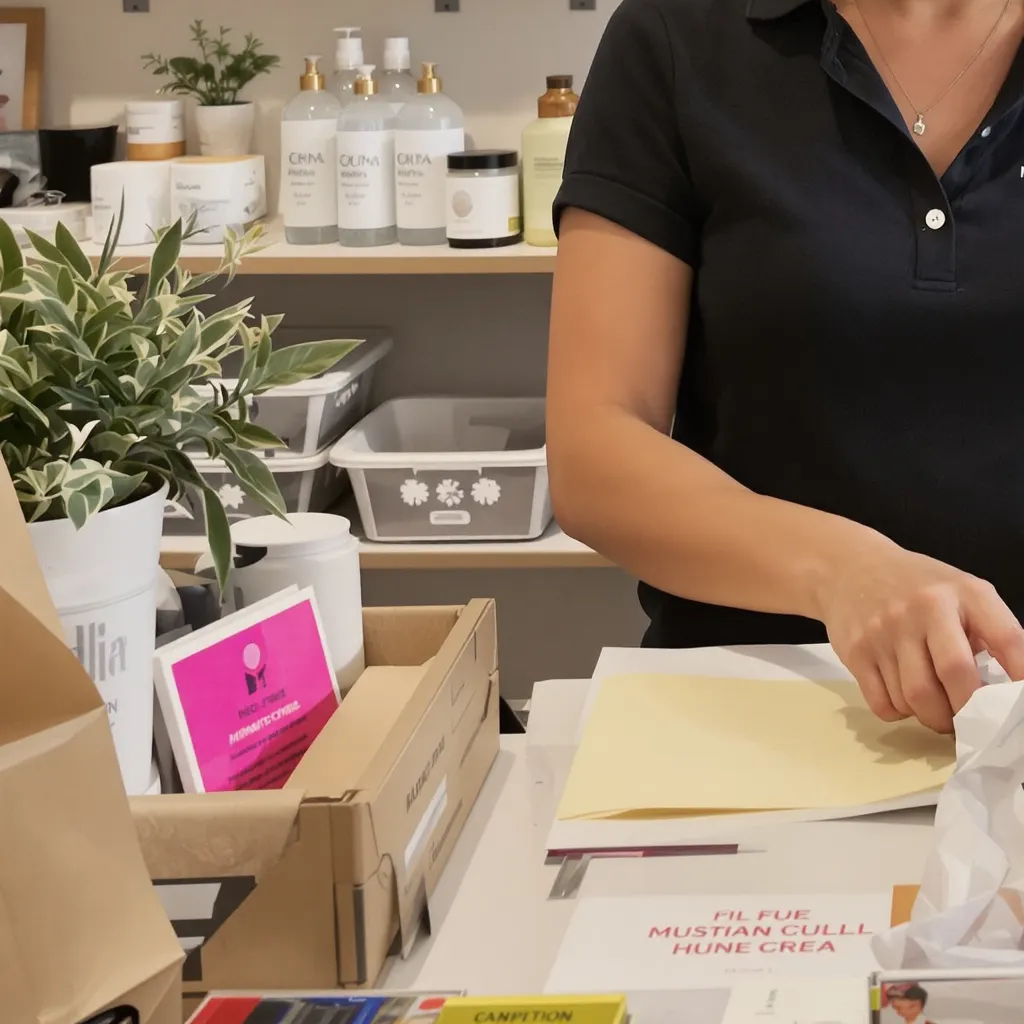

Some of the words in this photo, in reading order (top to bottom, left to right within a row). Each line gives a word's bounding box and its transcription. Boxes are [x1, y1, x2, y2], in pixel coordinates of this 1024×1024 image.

[757, 909, 811, 921] FUE
[648, 925, 771, 938] MUSTIAN
[672, 942, 751, 955] HUNE
[758, 940, 836, 954] CREA
